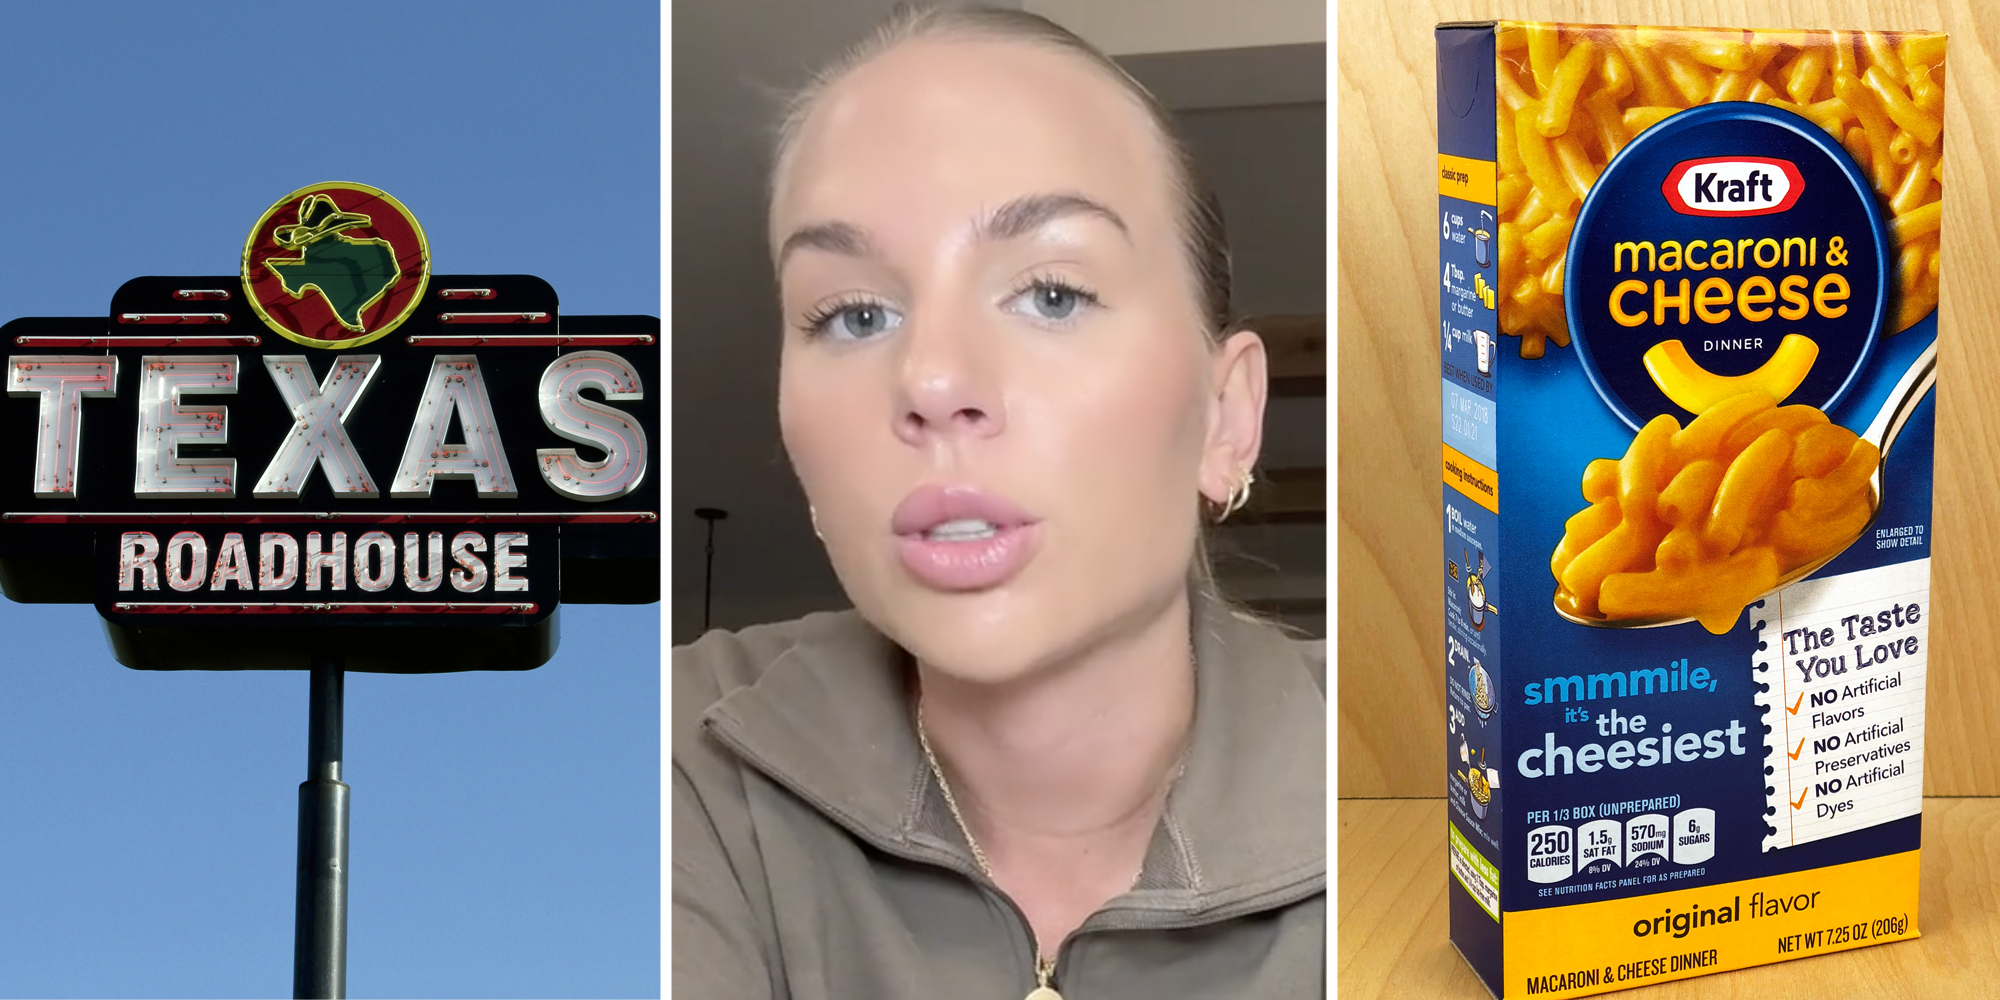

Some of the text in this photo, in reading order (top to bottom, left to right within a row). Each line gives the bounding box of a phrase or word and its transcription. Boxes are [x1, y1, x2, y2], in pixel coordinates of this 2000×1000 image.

[1442, 165, 1468, 187] classic prep
[1694, 170, 1773, 203] Kraft
[1443, 211, 1464, 240] 6 cups
[1451, 230, 1466, 244] water
[1614, 236, 1849, 273] macaroni &
[1443, 262, 1451, 293] 4
[1451, 284, 1476, 303] margarine
[1452, 301, 1474, 318] or butter
[1452, 327, 1462, 343] cup
[1462, 329, 1472, 344] milk
[1703, 338, 1763, 352] DINNER
[1444, 361, 1494, 394] BEST WHEN USED BY
[1460, 396, 1472, 416] MAR
[7, 350, 648, 501] TEXAS
[1445, 460, 1494, 497] cooking instructions
[1446, 504, 1477, 535] 1 BOIL water
[1876, 525, 1924, 538] ENLARGED TO
[1876, 536, 1923, 550] SHOW DETAIL
[118, 531, 529, 593] ROADHOUSE
[1783, 603, 1921, 655] The Taste
[1448, 636, 1455, 667] 2
[1796, 635, 1919, 683] You Love
[1524, 658, 1717, 705] smmmile,
[1810, 671, 1901, 708] NO Artificial
[1449, 704, 1456, 734] 3
[1565, 707, 1647, 737] it's the
[1812, 707, 1865, 729] Flavors
[1517, 720, 1746, 779] cheesiest
[1813, 717, 1904, 754] NO Artificial
[1815, 741, 1911, 775] Preservatives
[1815, 760, 1905, 798] NO Artificial
[1527, 794, 1681, 824] PER 1/3 BOX (UNPREPARED)
[1817, 799, 1854, 820] Dyes
[1588, 830, 1612, 845] 1.5g
[1631, 824, 1666, 840] 570mg
[1678, 832, 1710, 846] SUGARS
[1688, 819, 1700, 834] 6g
[1531, 831, 1570, 856] 250
[1583, 845, 1616, 858] SAT FAT
[1631, 840, 1664, 852] SODIUM
[1530, 855, 1570, 868] CALORIES
[1588, 864, 1612, 874] 8% DV
[1634, 857, 1660, 868] 24% DV
[1538, 868, 1706, 897] SEE NUTRITION FACTS PANEL FOR AS PREPARED
[1633, 890, 1821, 938] original flavor
[1778, 913, 1908, 954] NET WT 7.25 OZ (206g)
[1527, 949, 1718, 995] MACARONI & CHEESE DINNER
